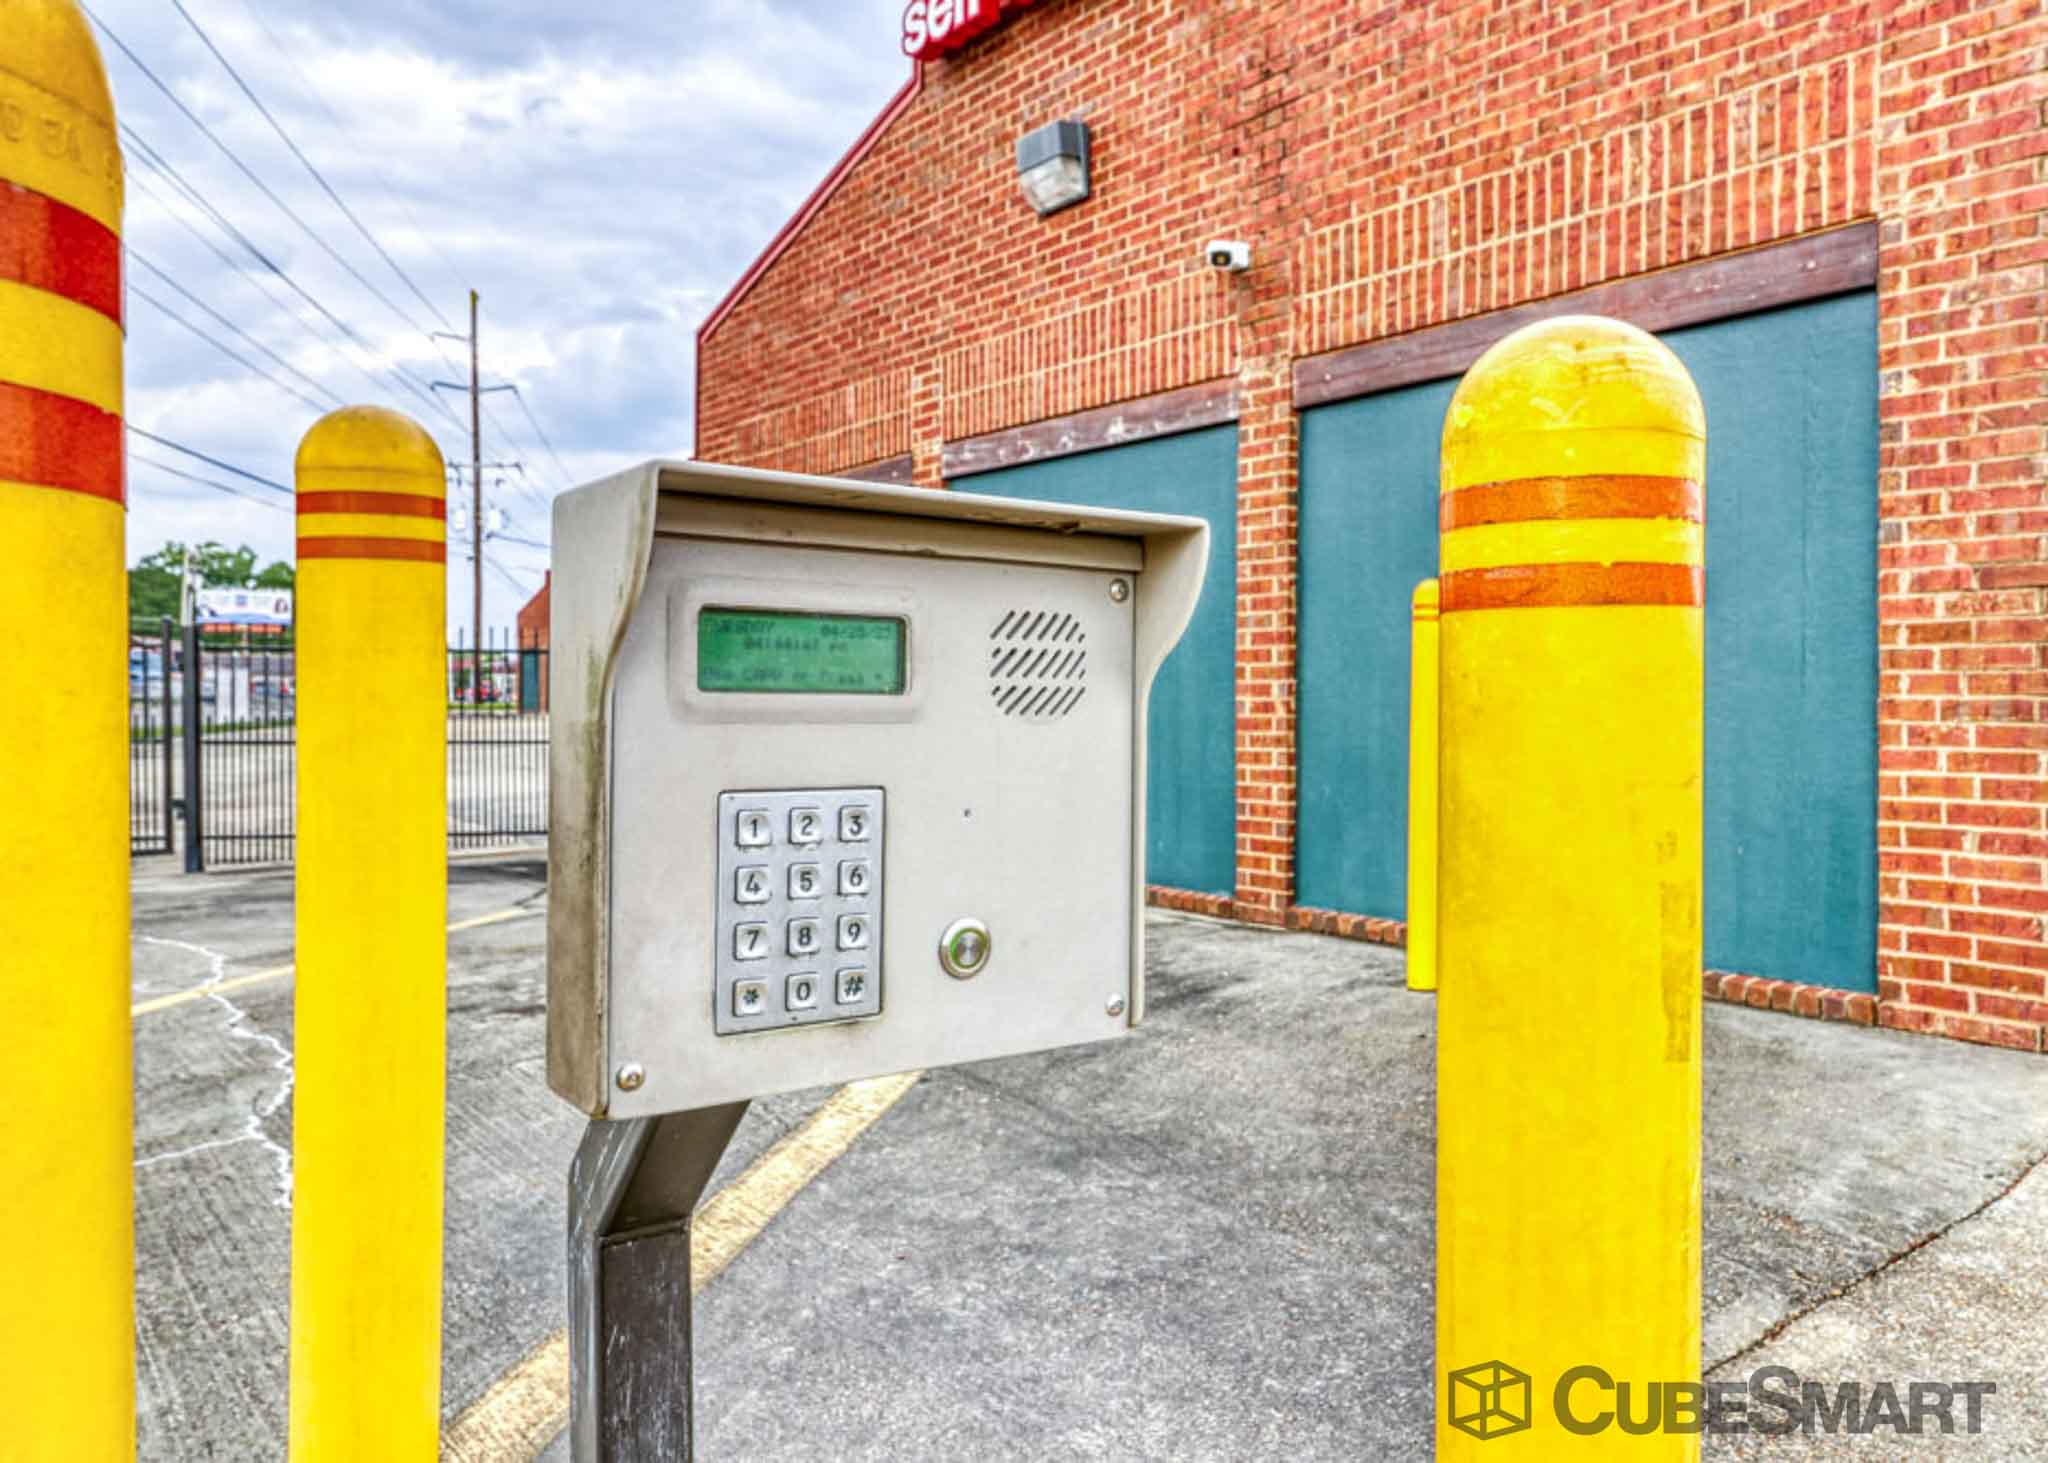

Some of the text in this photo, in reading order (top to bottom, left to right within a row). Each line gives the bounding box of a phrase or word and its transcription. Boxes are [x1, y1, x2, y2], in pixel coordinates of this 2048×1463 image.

[750, 815, 863, 838] 1 2 3
[745, 867, 863, 894] 4 5 6
[746, 922, 861, 951] 7 8 9
[796, 981, 811, 1003] 0
